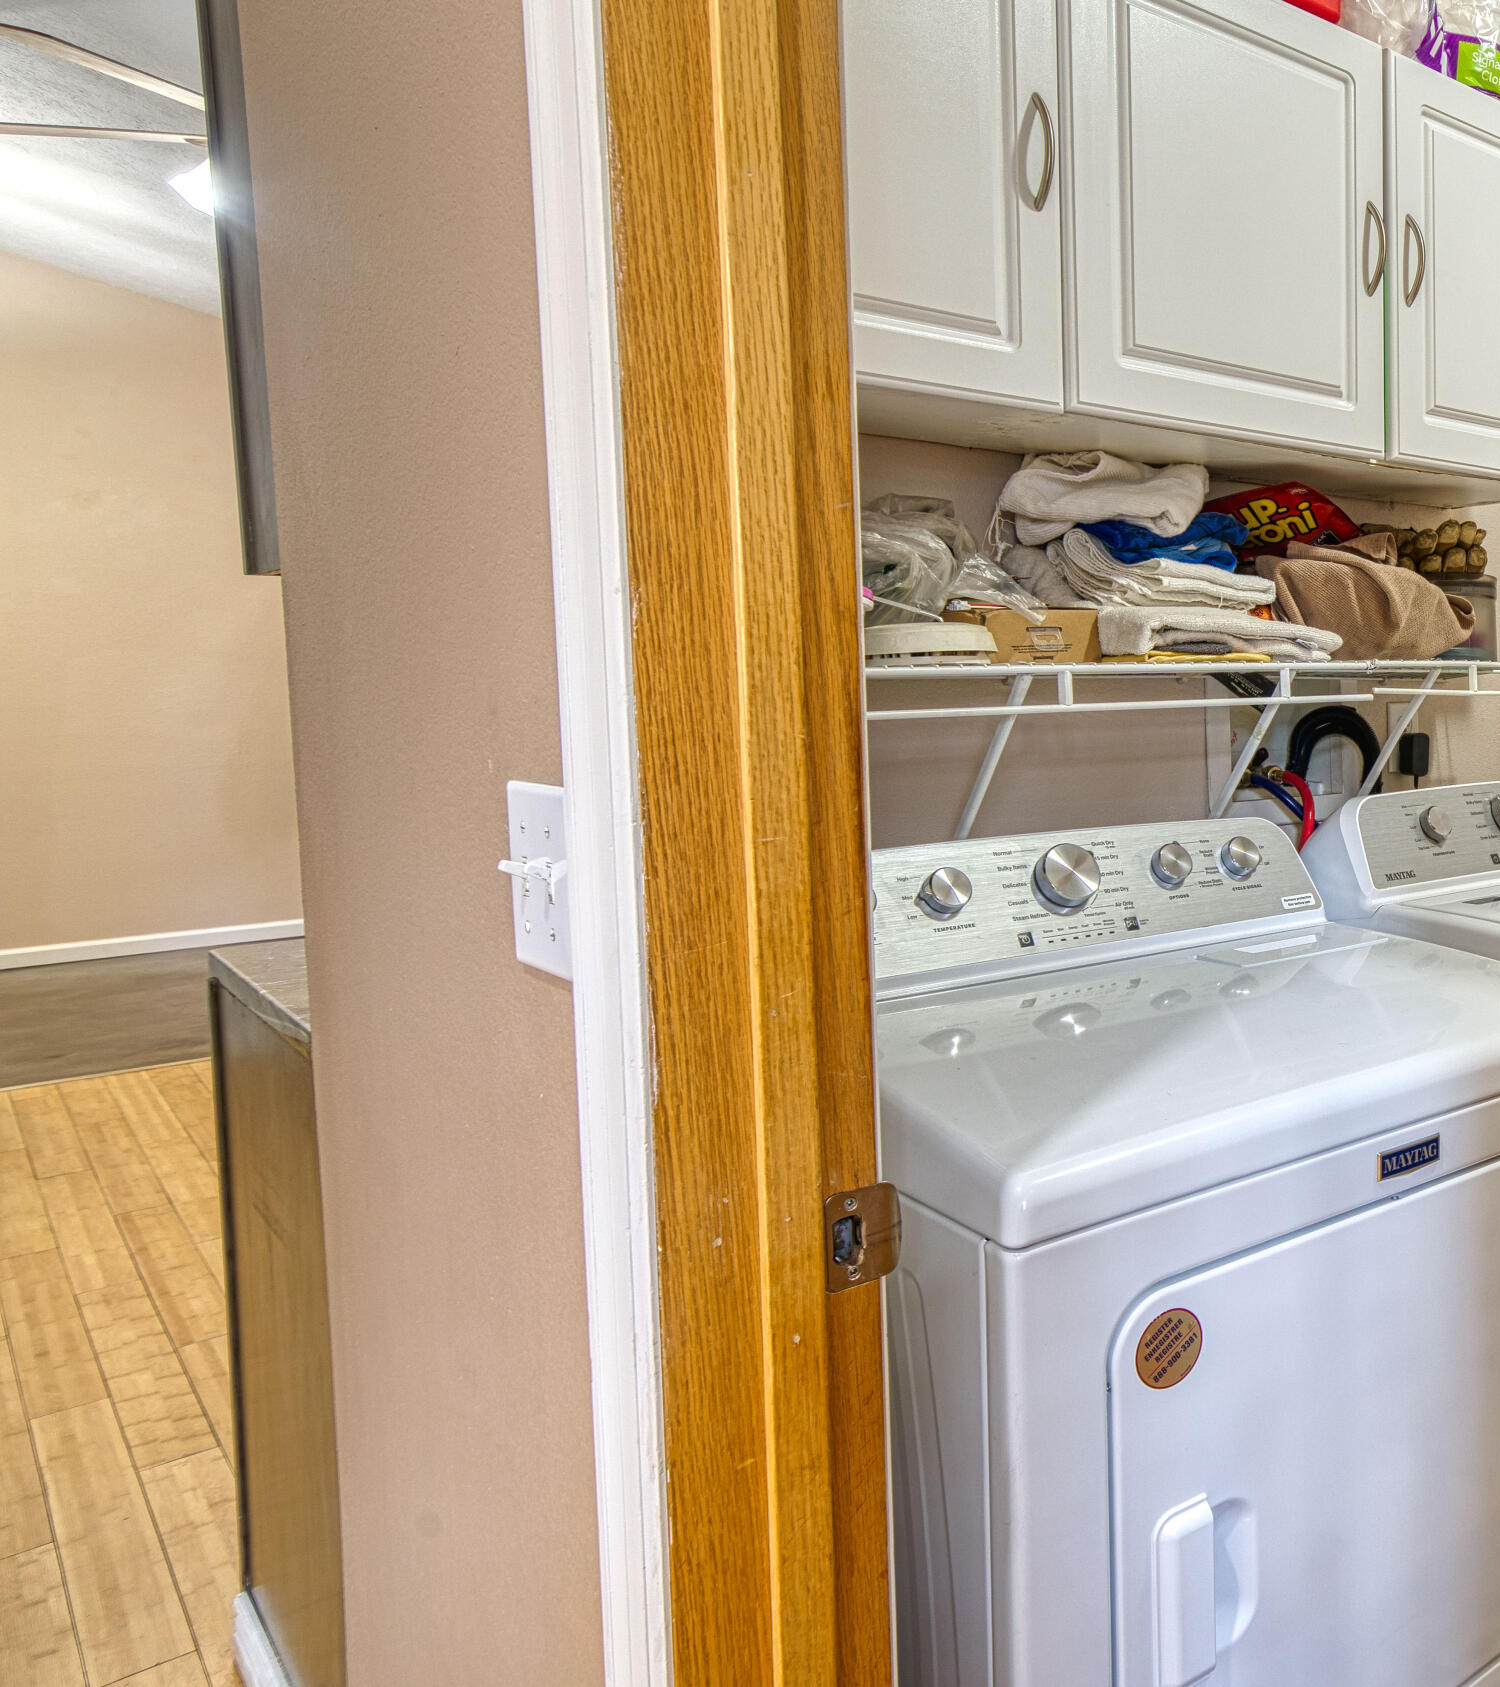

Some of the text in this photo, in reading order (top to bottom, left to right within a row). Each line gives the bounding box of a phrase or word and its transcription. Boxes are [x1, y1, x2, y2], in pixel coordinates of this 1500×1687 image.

[1229, 498, 1288, 529] uP-
[1247, 501, 1318, 546] roni
[1002, 881, 1028, 889] Delicates
[1385, 870, 1416, 881] MAYTAG
[933, 923, 976, 933] TEMPERATURE
[1030, 912, 1051, 920] Refresh
[1384, 1143, 1437, 1173] MAYTAG
[1144, 1317, 1173, 1349] REGISTER
[1144, 1318, 1184, 1362] ENREGISTRER
[1154, 1331, 1183, 1363] REGISTRE
[1152, 1332, 1198, 1383] 888-900-3381
